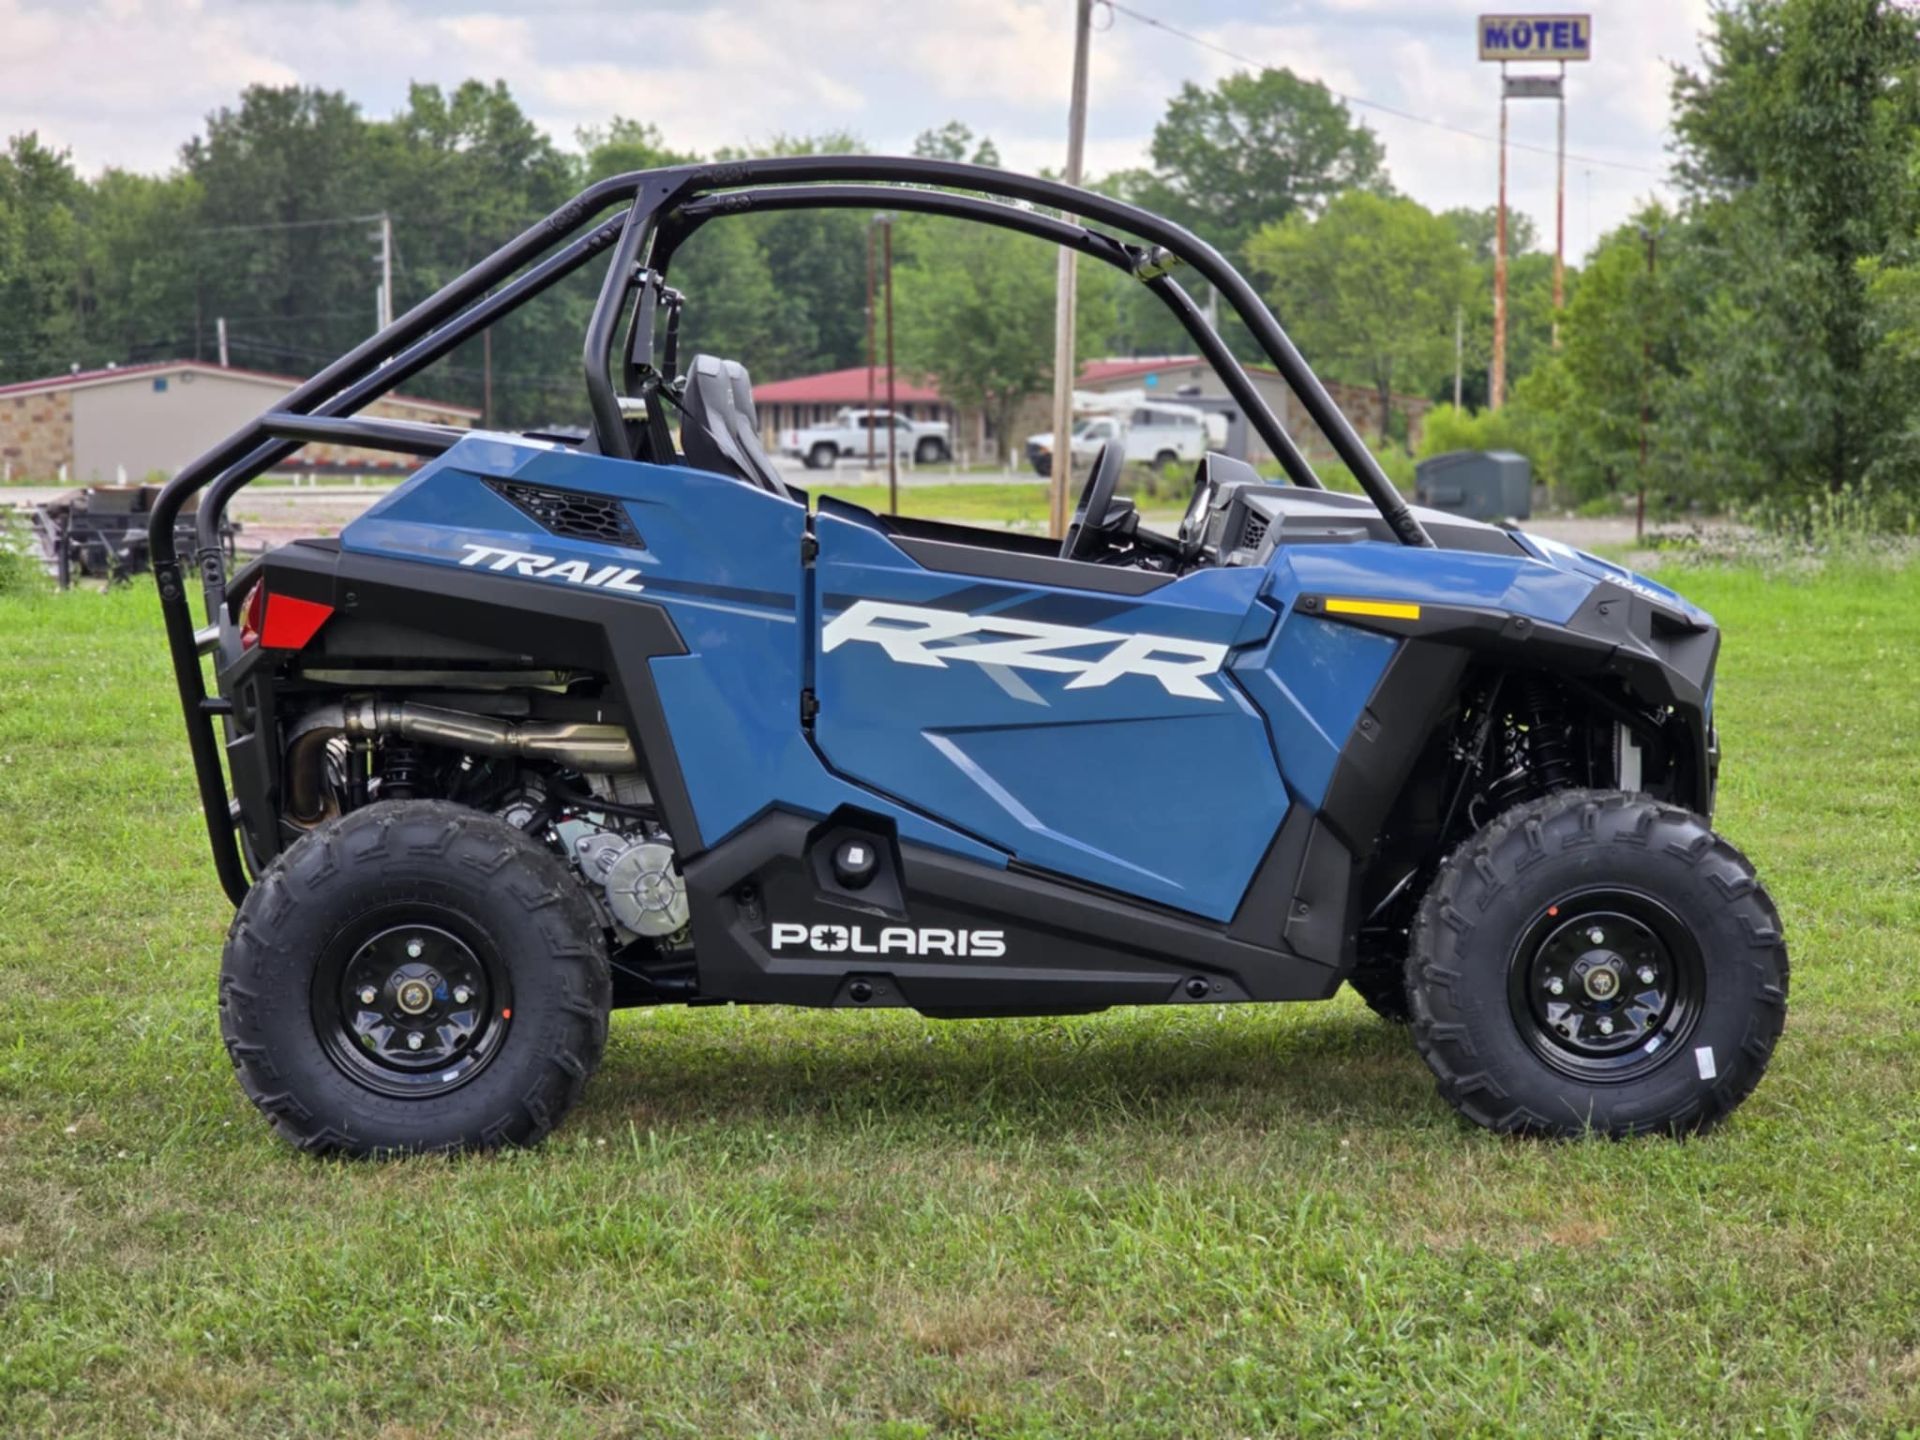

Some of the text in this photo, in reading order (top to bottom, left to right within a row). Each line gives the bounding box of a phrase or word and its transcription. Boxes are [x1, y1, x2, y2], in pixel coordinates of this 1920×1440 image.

[1485, 21, 1587, 49] MOTEL
[459, 543, 645, 592] TRAIL
[822, 600, 1230, 702] RZR
[771, 922, 1006, 957] POLARIS
